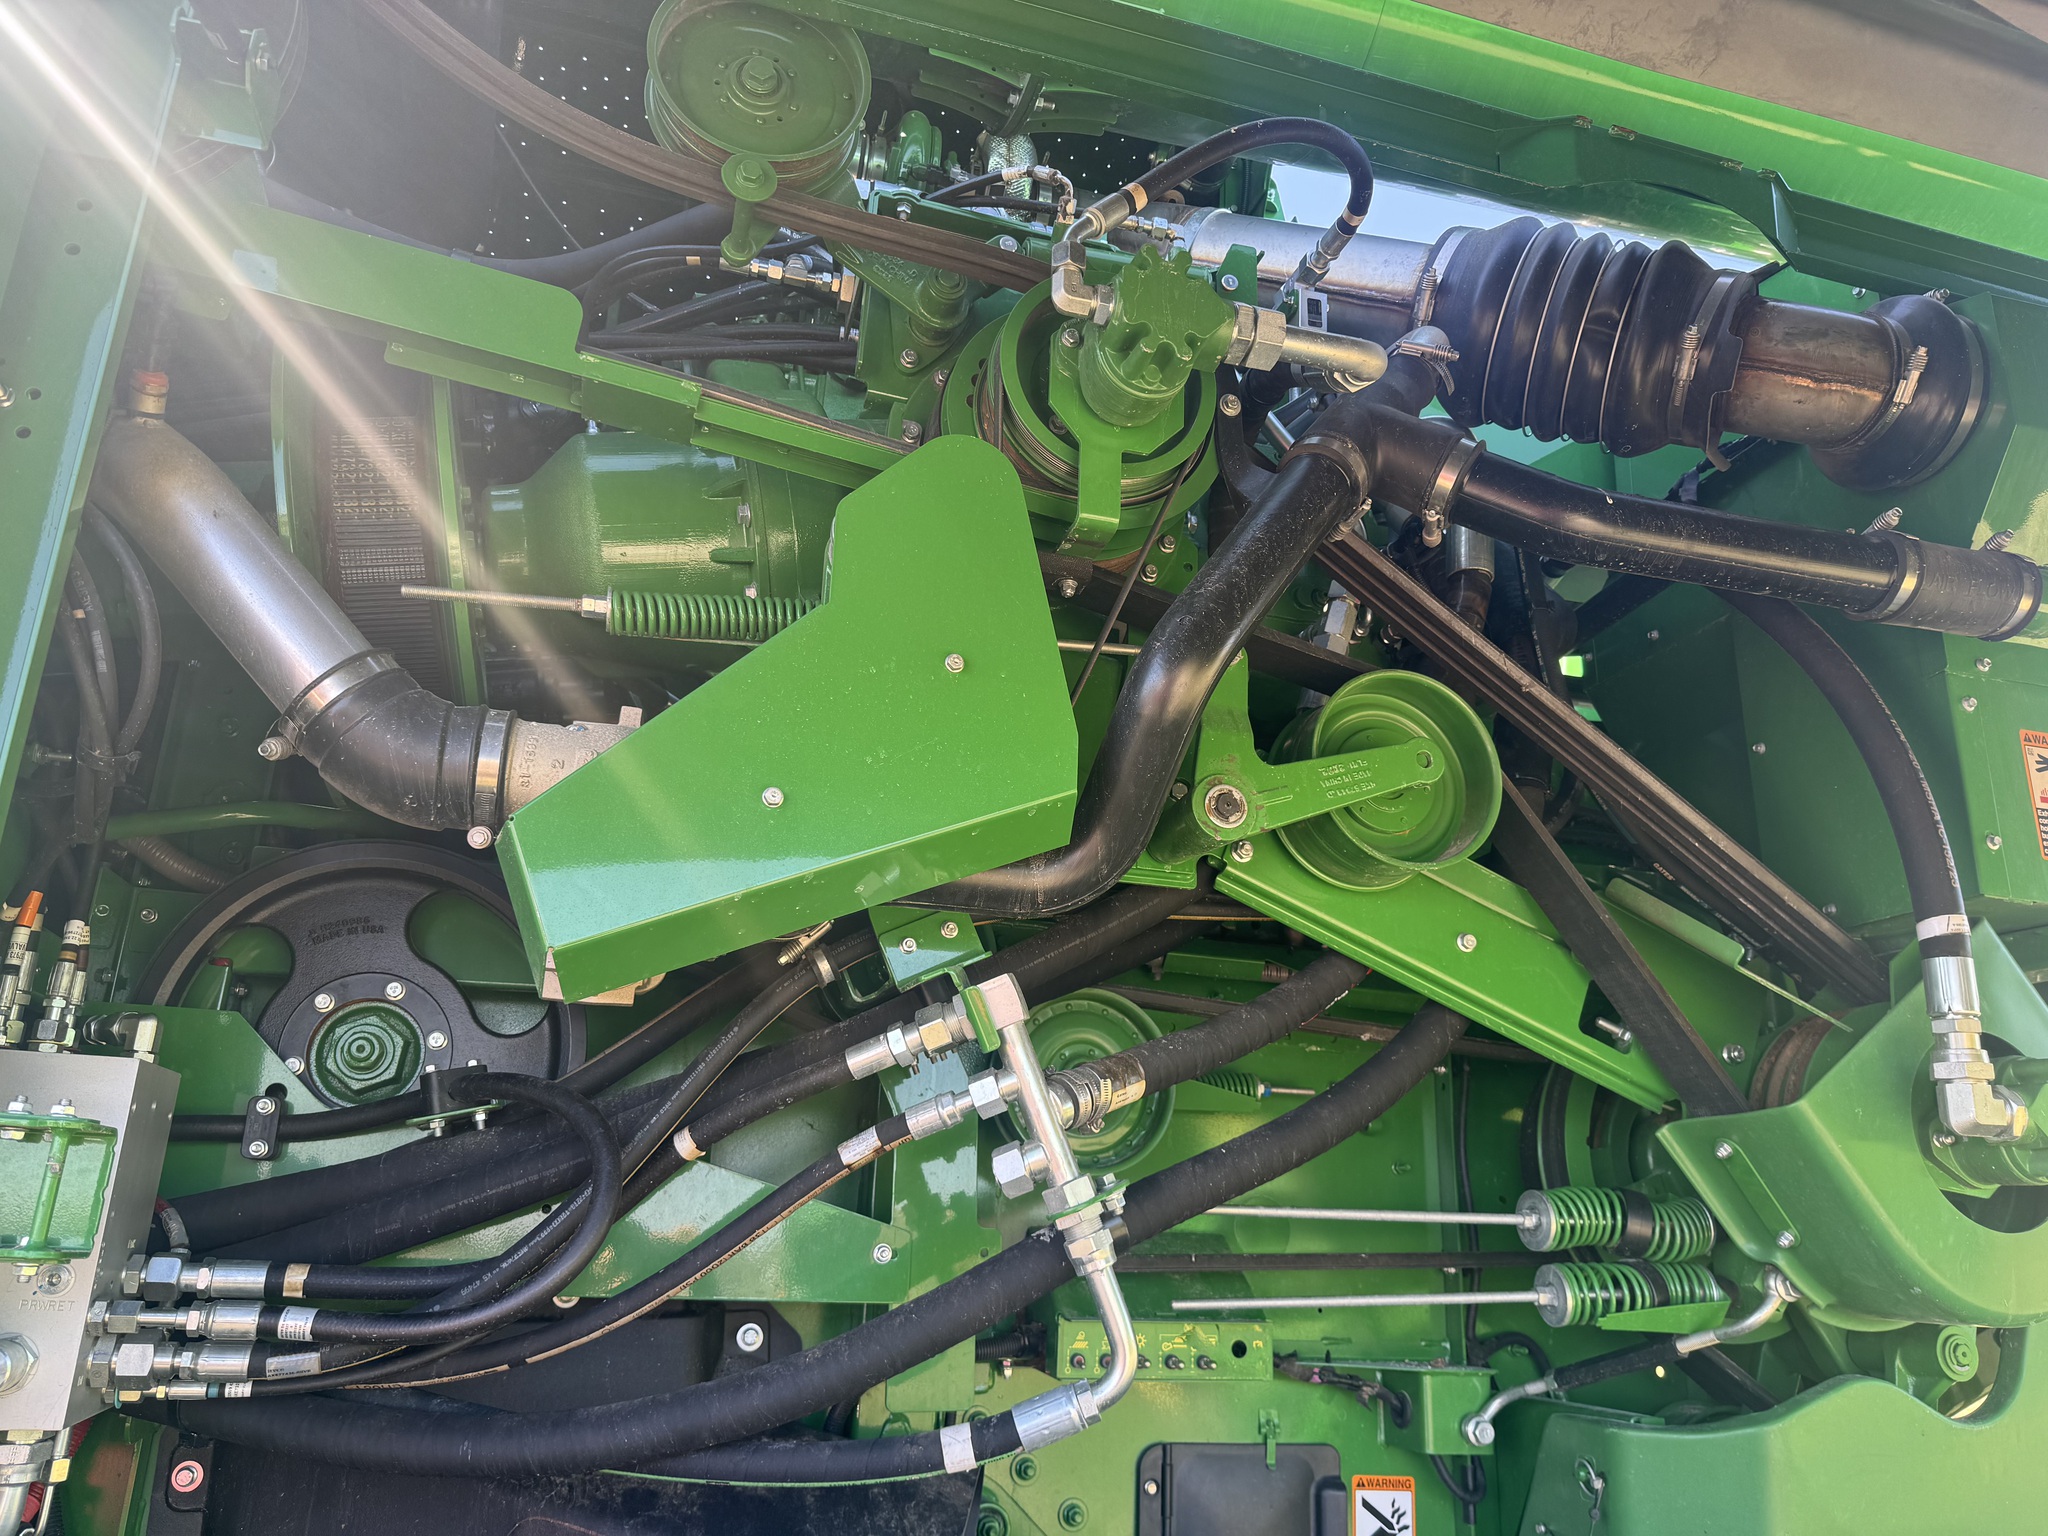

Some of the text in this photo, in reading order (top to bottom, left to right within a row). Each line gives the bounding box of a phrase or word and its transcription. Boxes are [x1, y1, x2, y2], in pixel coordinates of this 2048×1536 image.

[1928, 571, 2015, 601] AIR FLOW
[550, 758, 564, 770] 2
[1651, 861, 1674, 881] GATES
[311, 924, 384, 945] MADE IN USA
[18, 1299, 75, 1311] PRWRET
[1366, 1478, 1411, 1488] WARNING
